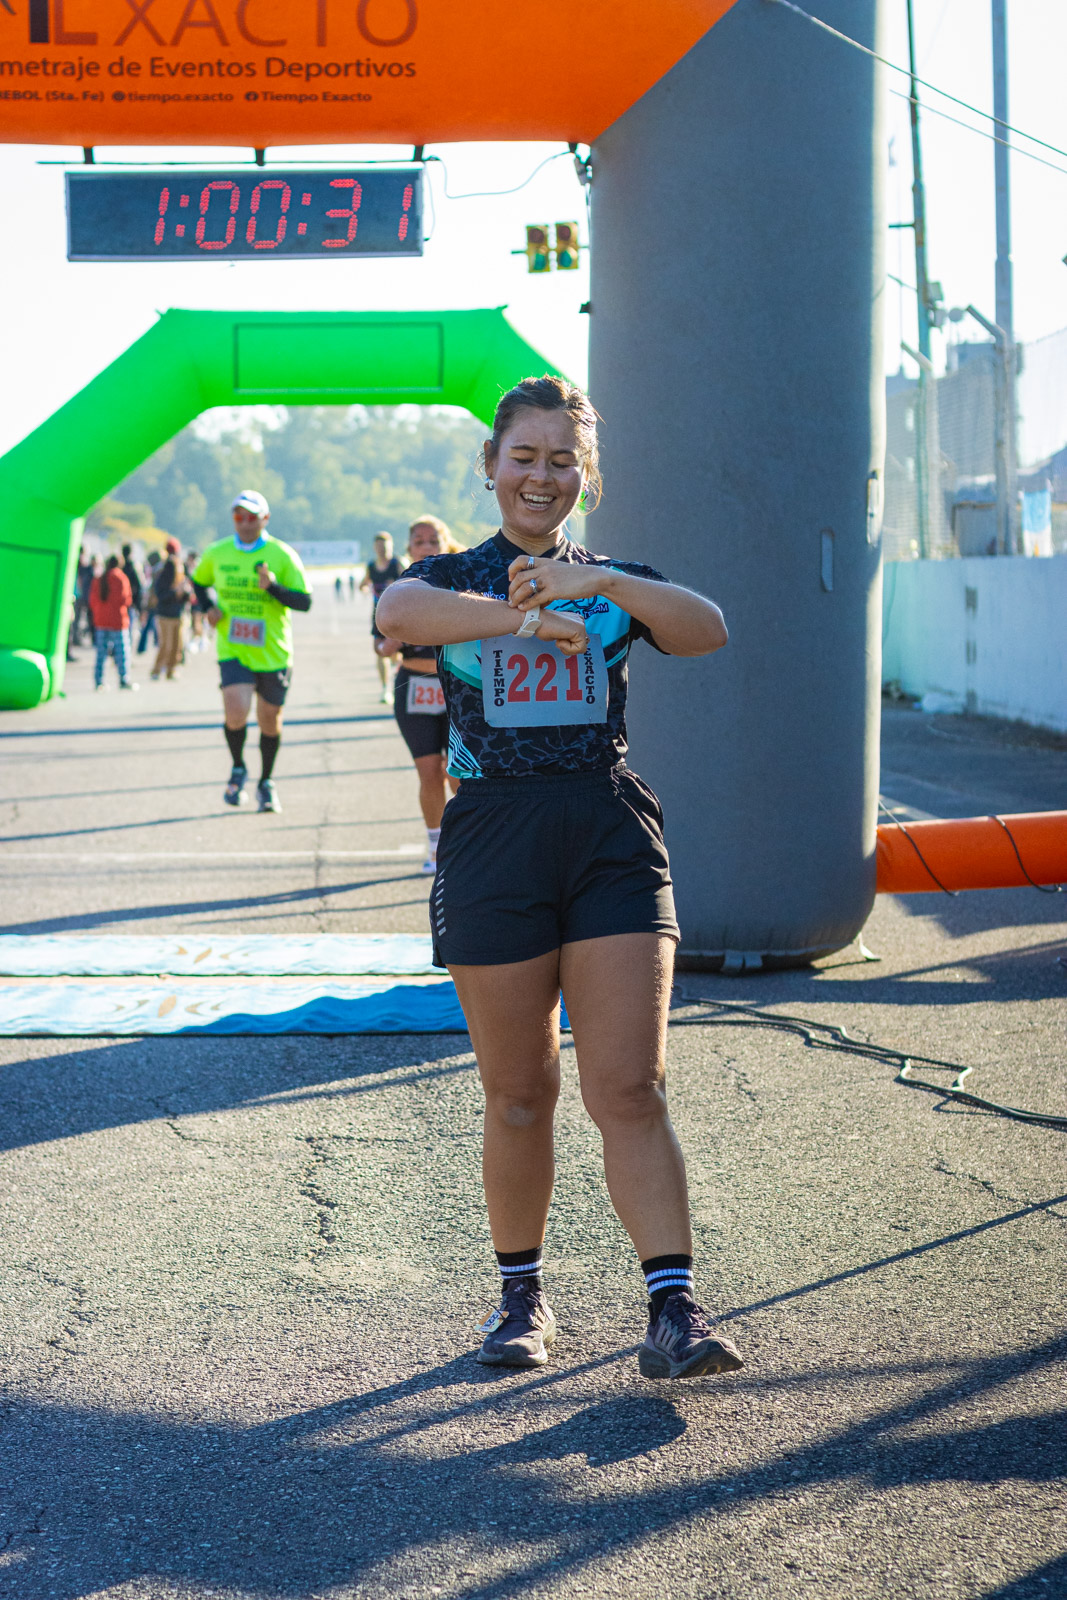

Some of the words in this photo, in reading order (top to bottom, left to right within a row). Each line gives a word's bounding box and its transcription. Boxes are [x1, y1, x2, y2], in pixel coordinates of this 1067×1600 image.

[0, 56, 100, 82] metraje
[107, 56, 142, 77] de
[150, 56, 256, 77] Eventos
[265, 57, 416, 82] Deportivos
[82, 90, 104, 102] Fe)
[262, 91, 318, 103] Tiempo
[322, 91, 372, 102] Exacto
[493, 650, 505, 707] TIEMPO
[507, 653, 583, 703] 221
[584, 647, 596, 705] EXACTO
